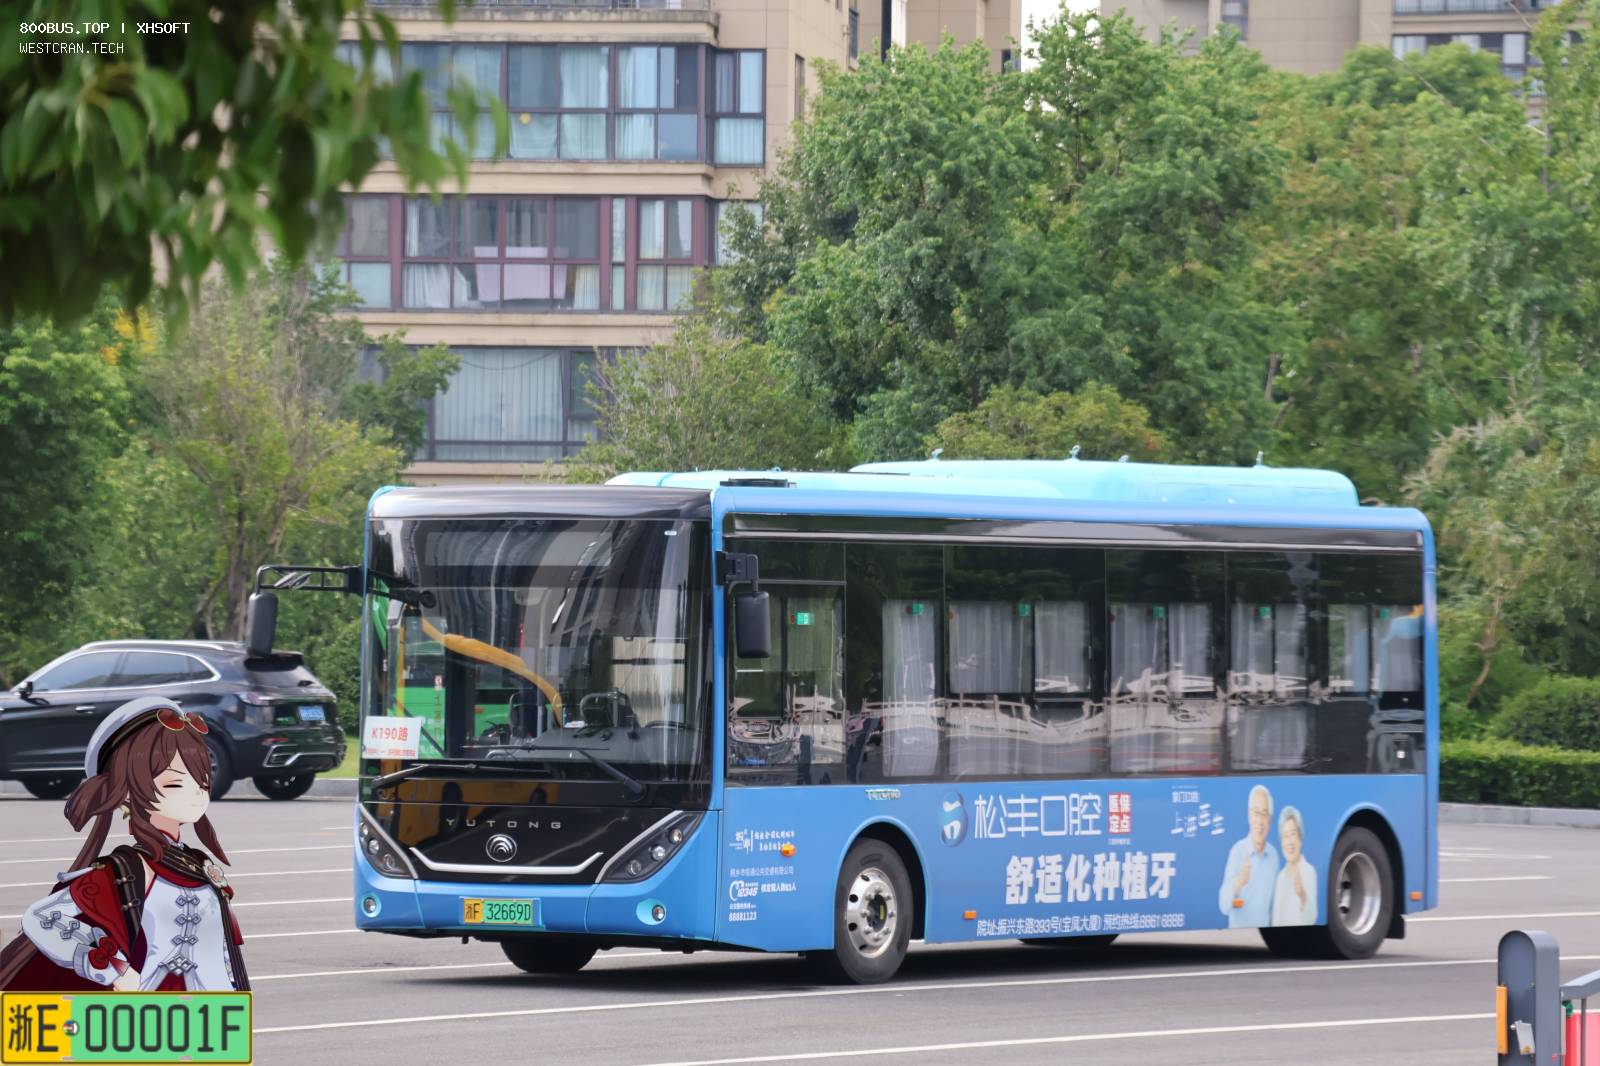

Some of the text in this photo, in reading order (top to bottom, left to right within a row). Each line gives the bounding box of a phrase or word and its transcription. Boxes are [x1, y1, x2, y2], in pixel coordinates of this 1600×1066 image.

[371, 727, 408, 741] K190路
[446, 818, 562, 829] YUTONG
[974, 792, 1102, 839] 松丰口腔
[1005, 851, 1177, 906] 舒适化种植牙
